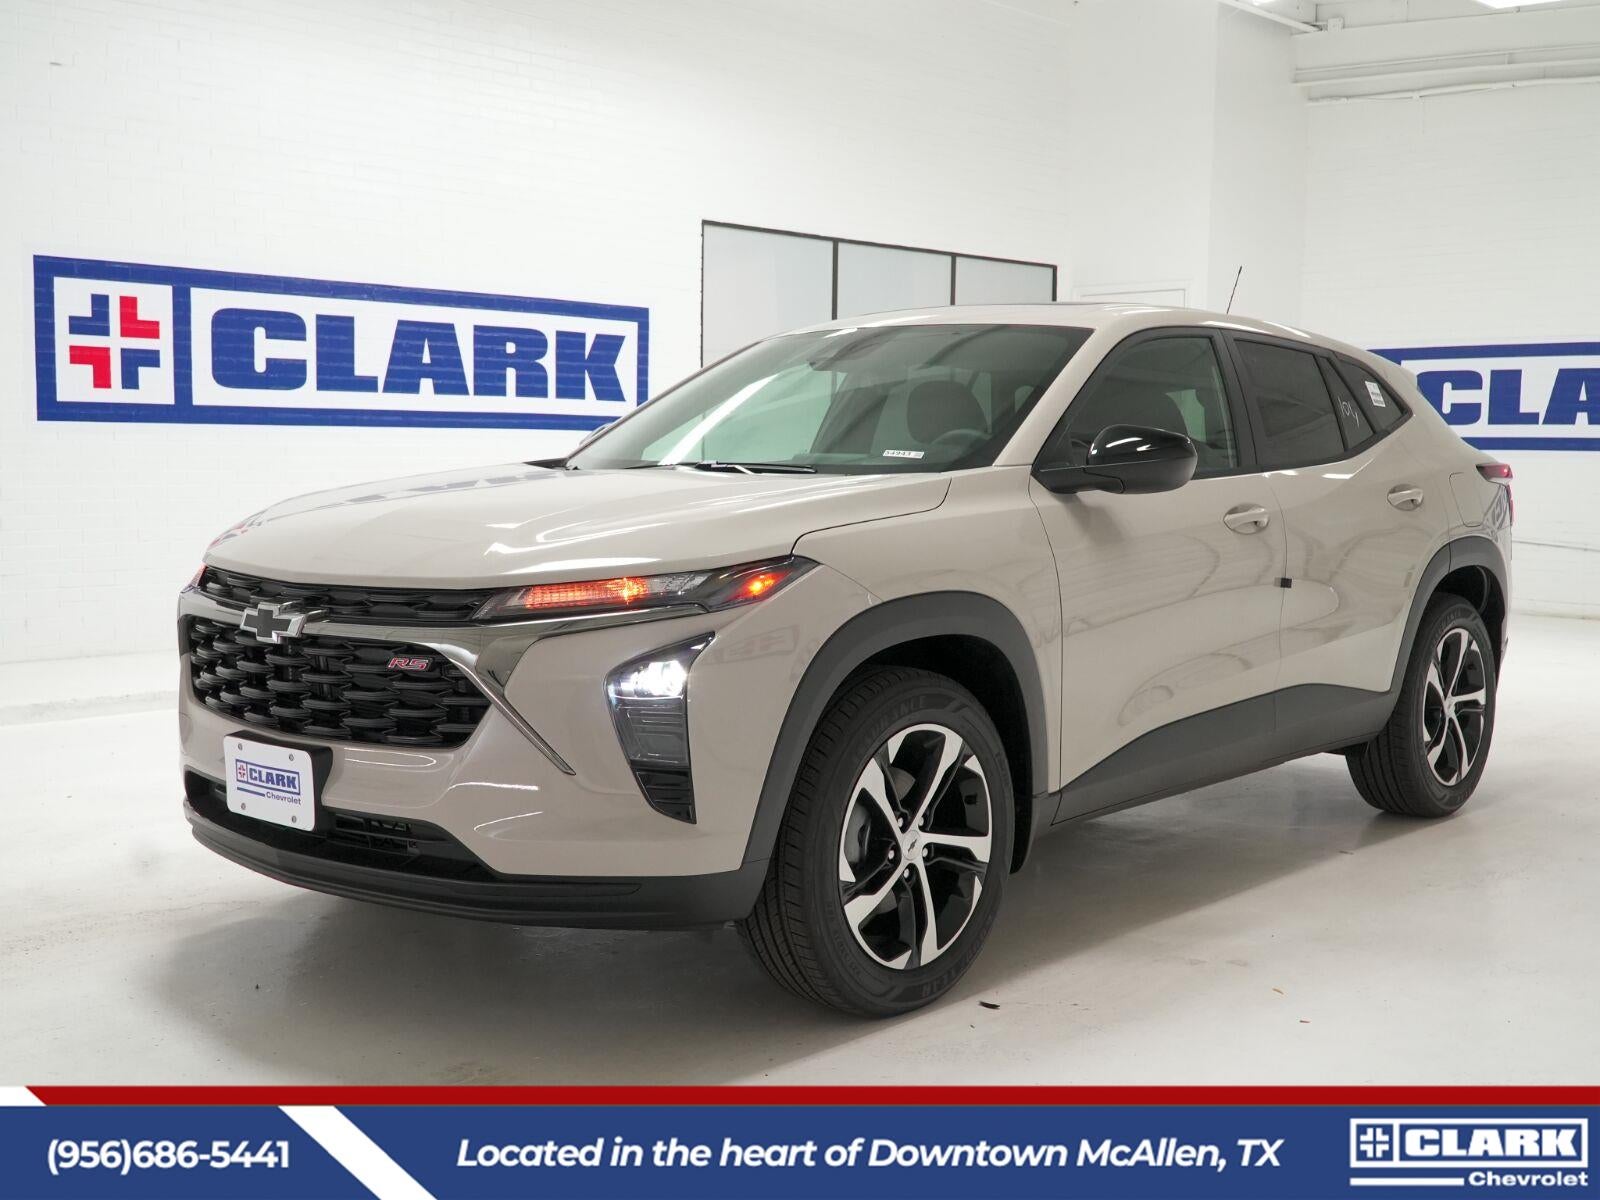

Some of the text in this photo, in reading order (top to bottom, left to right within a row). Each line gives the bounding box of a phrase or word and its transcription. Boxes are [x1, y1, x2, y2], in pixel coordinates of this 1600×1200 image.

[211, 307, 626, 402] CLARK
[388, 657, 429, 670] RS
[248, 767, 298, 790] CLARK
[265, 791, 302, 806] Chevrolet
